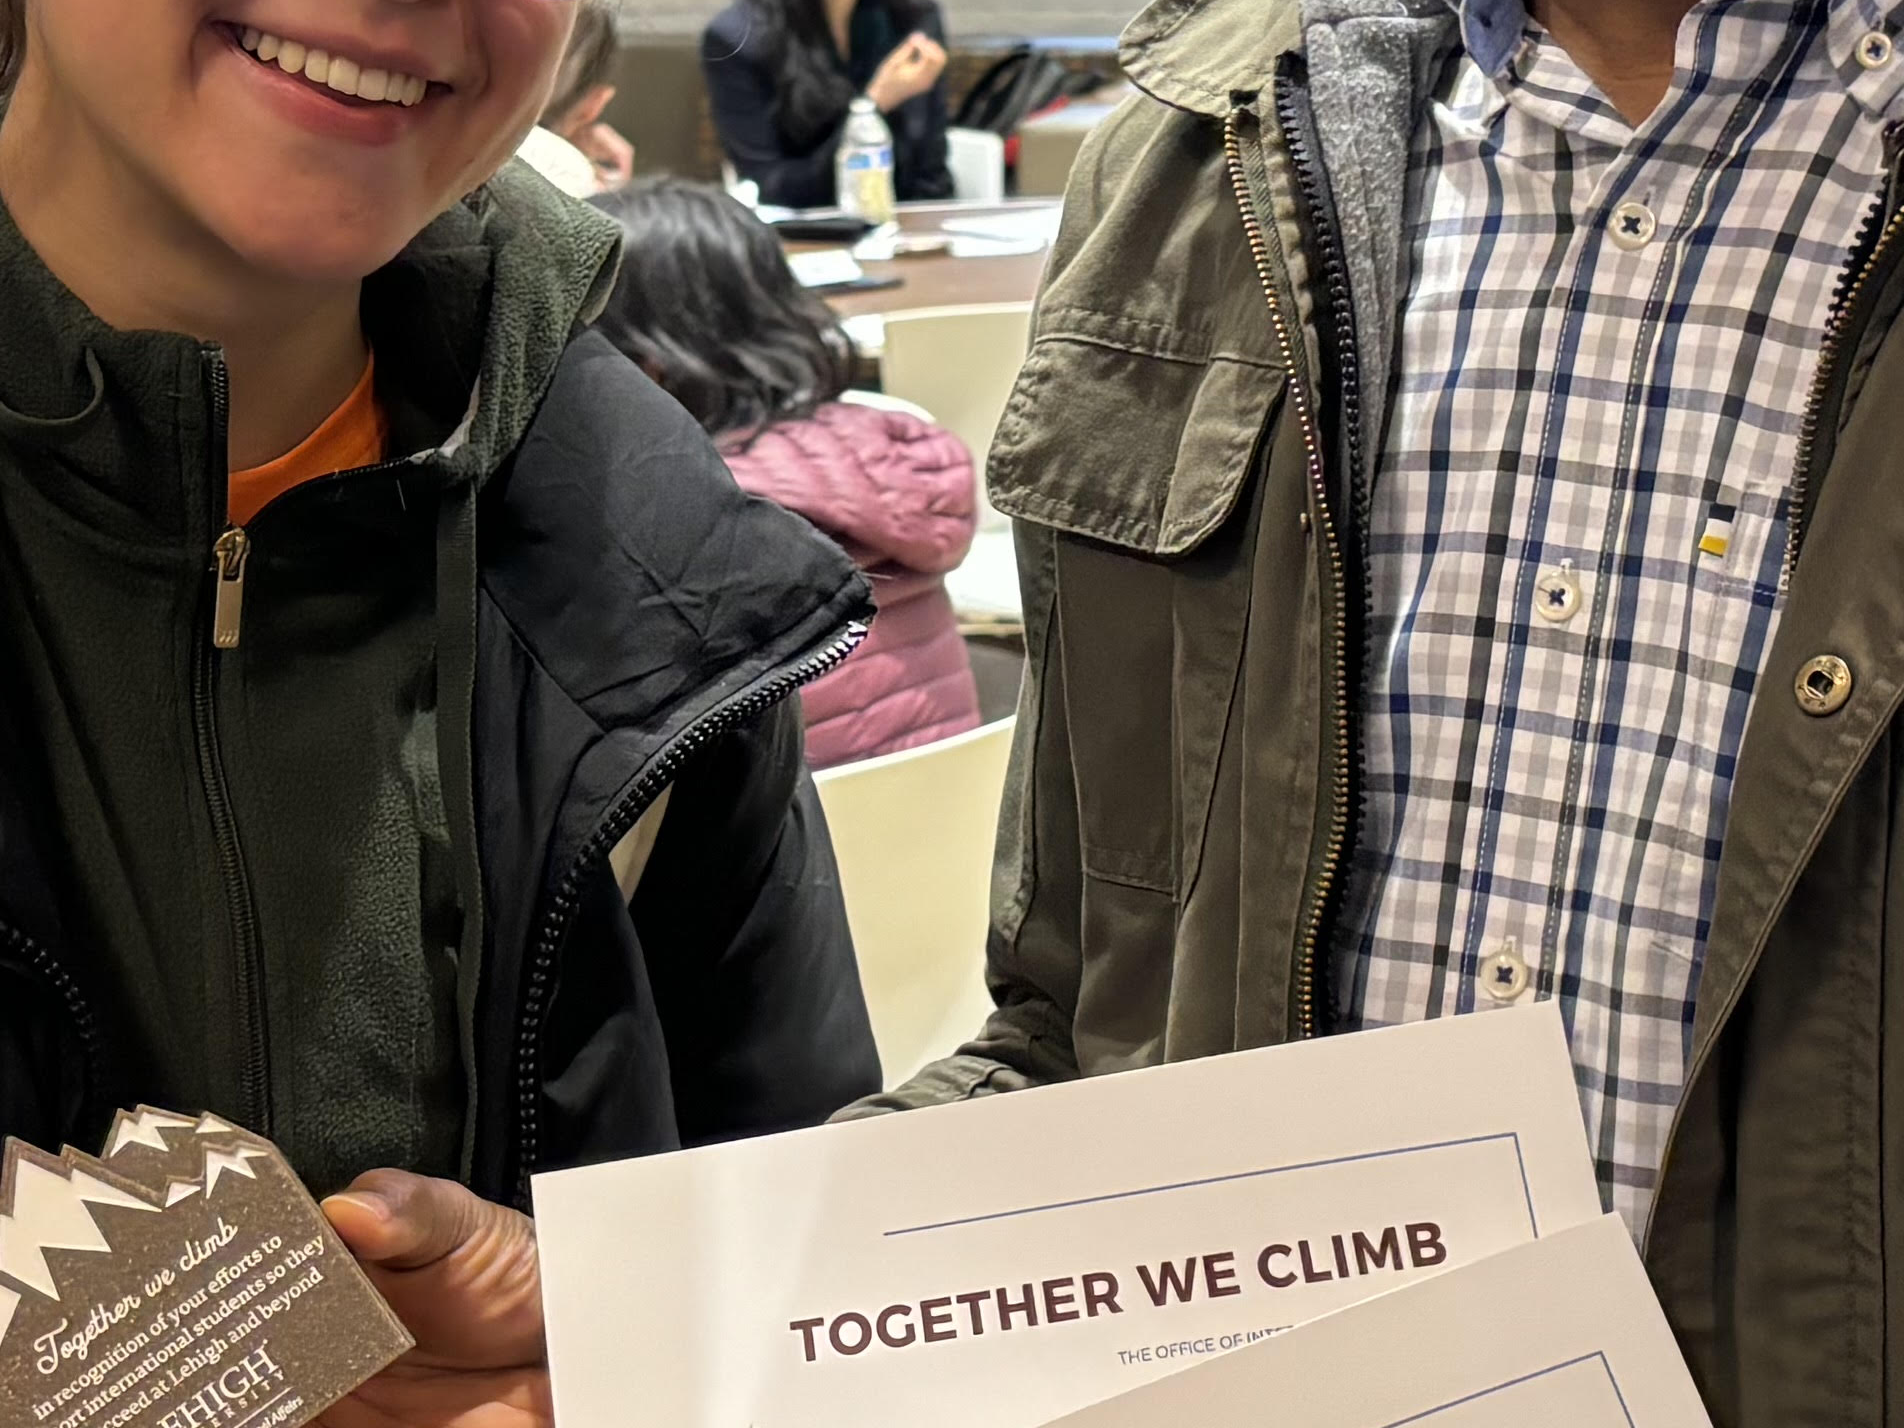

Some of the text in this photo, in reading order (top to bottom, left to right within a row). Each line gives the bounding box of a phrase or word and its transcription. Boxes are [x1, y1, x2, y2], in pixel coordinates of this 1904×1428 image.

[32, 1235, 282, 1421] in recognition of your efforts to
[33, 1217, 239, 1375] Together we climb
[83, 1326, 194, 1417] international
[193, 1279, 265, 1337] students
[265, 1265, 286, 1285] so
[285, 1235, 326, 1271] they
[153, 1380, 170, 1402] at
[167, 1336, 229, 1387] Lehigh
[228, 1312, 262, 1343] and
[260, 1266, 324, 1320] beyond
[789, 1221, 1448, 1362] TOGETHER WE CLIMB
[1118, 1347, 1152, 1365] THE
[1155, 1338, 1216, 1359] OFFICE
[1220, 1333, 1243, 1350] OF
[271, 1396, 304, 1425] Affairs
